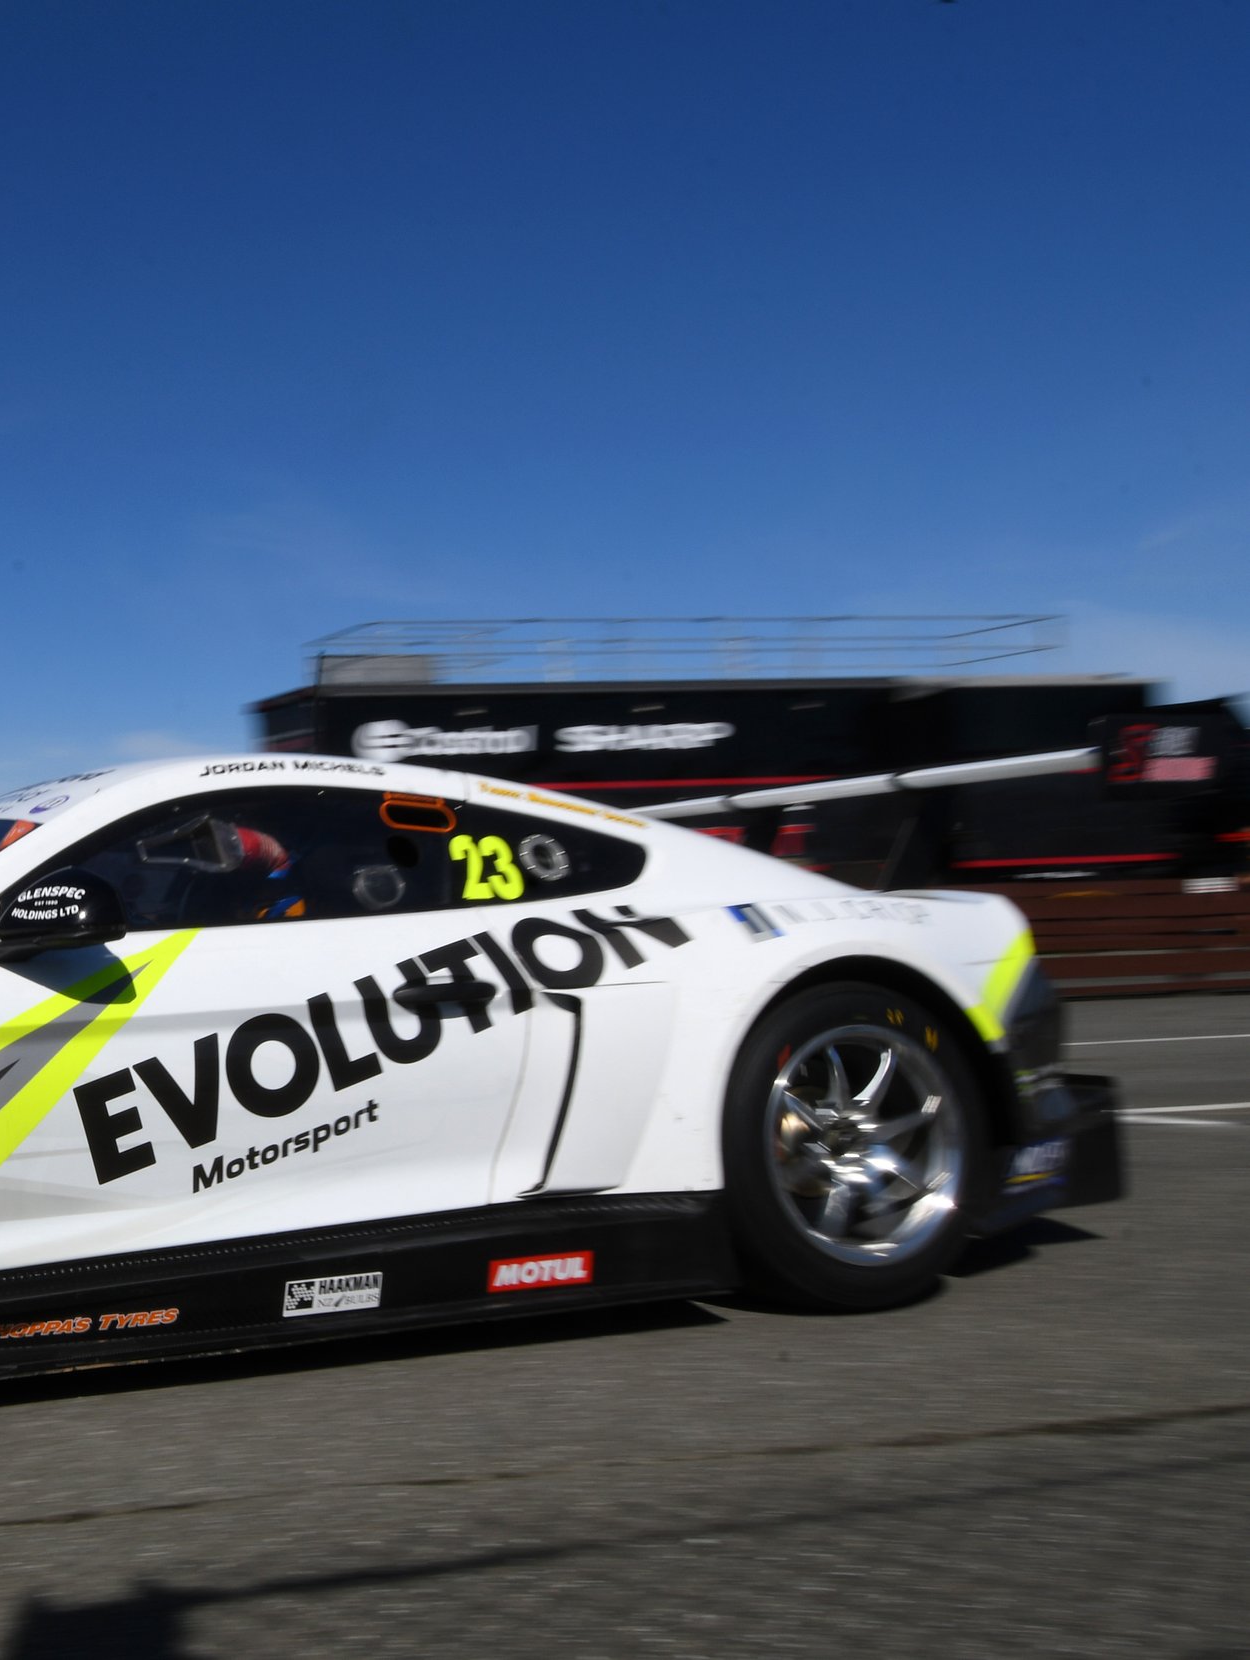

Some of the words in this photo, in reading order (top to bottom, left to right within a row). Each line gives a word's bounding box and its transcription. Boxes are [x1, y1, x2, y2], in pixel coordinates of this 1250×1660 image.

[199, 760, 284, 777] JORDAN
[449, 834, 524, 900] 23
[17, 886, 86, 903] GLENSPEC
[11, 907, 58, 921] HOLDINGS
[59, 904, 80, 917] LTD
[73, 905, 693, 1186] EVOLUTION
[192, 1099, 379, 1194] Motorsport
[492, 1256, 588, 1286] MOTUL
[318, 1274, 381, 1295] HAAKMAN
[98, 1307, 179, 1331] TYRES
